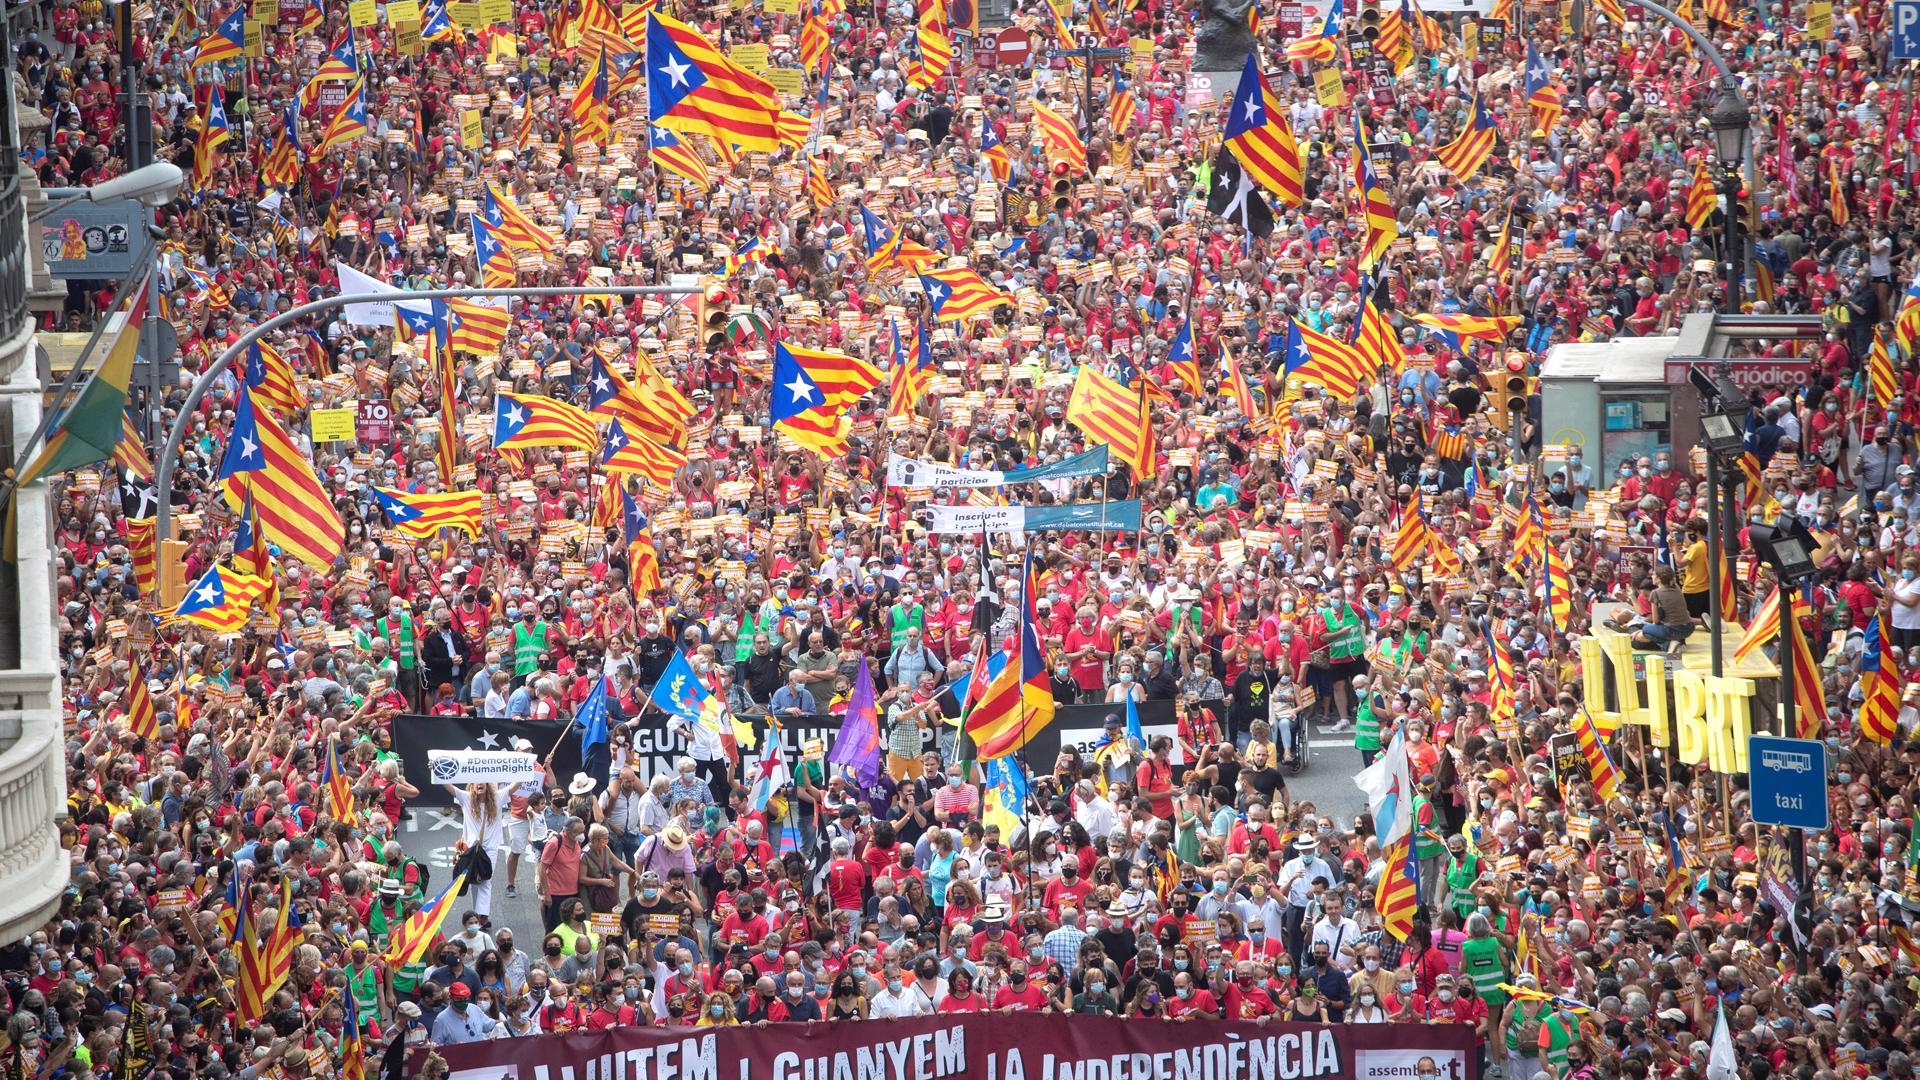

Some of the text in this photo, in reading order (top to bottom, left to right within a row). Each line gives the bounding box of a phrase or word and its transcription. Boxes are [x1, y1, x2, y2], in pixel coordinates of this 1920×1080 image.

[1898, 5, 1918, 34] P
[955, 511, 1007, 520] Inscriu-te
[461, 764, 533, 773] #HumanRights
[467, 757, 529, 765] #Democracy
[1559, 753, 1586, 769] 52%
[1775, 793, 1803, 809] taxi
[773, 1025, 966, 1080] GUANYEM
